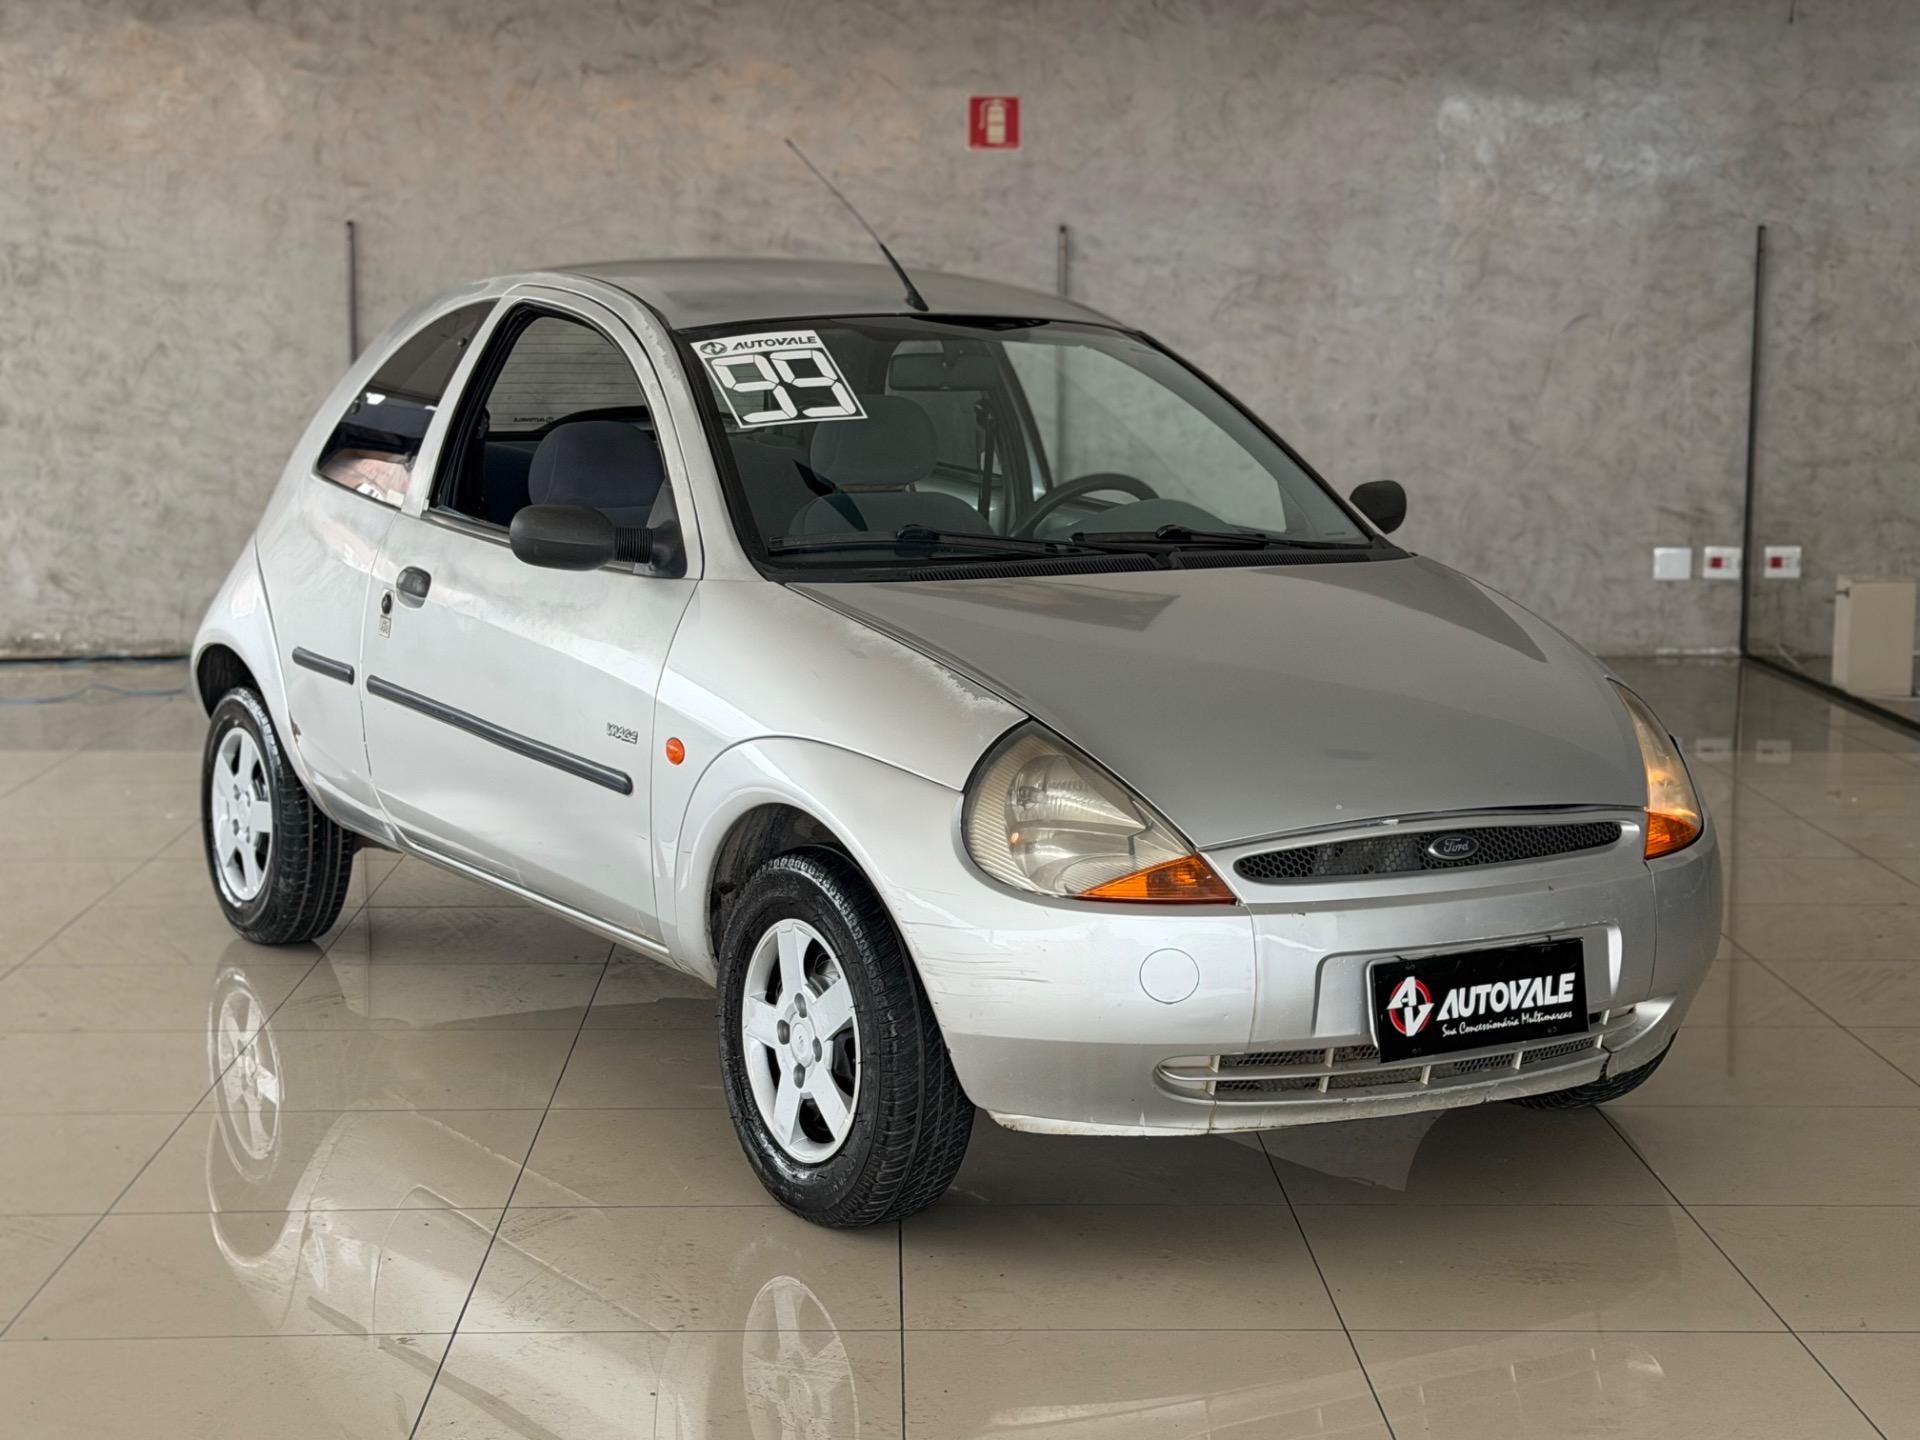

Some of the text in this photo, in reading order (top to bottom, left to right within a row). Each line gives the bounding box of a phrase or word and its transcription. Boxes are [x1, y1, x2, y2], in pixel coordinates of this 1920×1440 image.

[733, 336, 817, 351] AUTOVALE
[711, 350, 857, 423] 99
[1443, 838, 1469, 853] Ford
[1436, 972, 1575, 1021] AUTOVALE
[1442, 1010, 1573, 1037] Sua Concessionária Multimarcas
